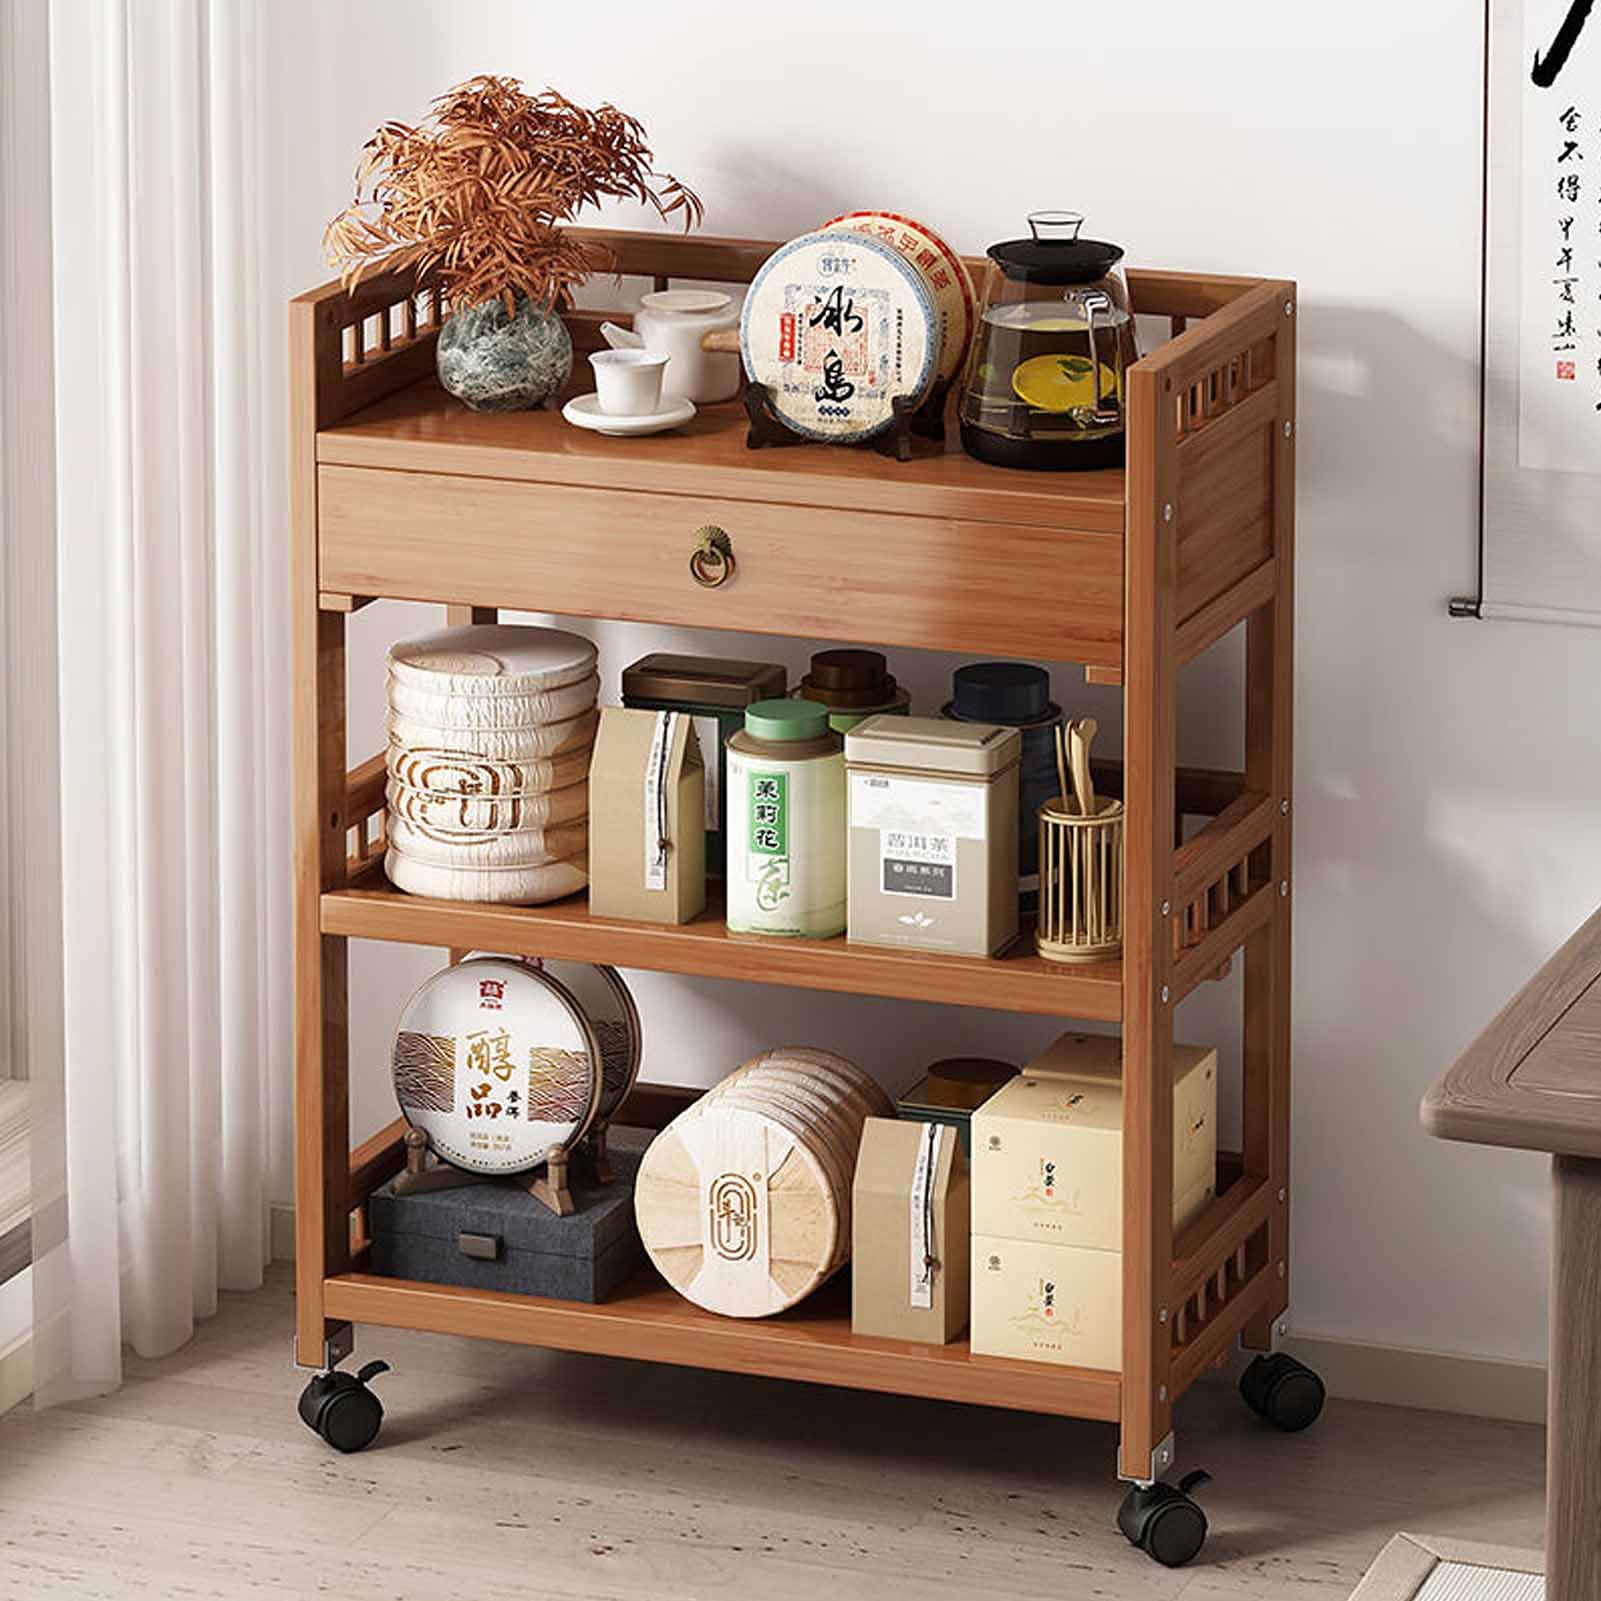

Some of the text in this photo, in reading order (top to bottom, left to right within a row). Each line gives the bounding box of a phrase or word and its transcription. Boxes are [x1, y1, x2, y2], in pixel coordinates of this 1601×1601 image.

[756, 780, 779, 848] 茉莉花
[465, 1027, 516, 1119] 醇品
